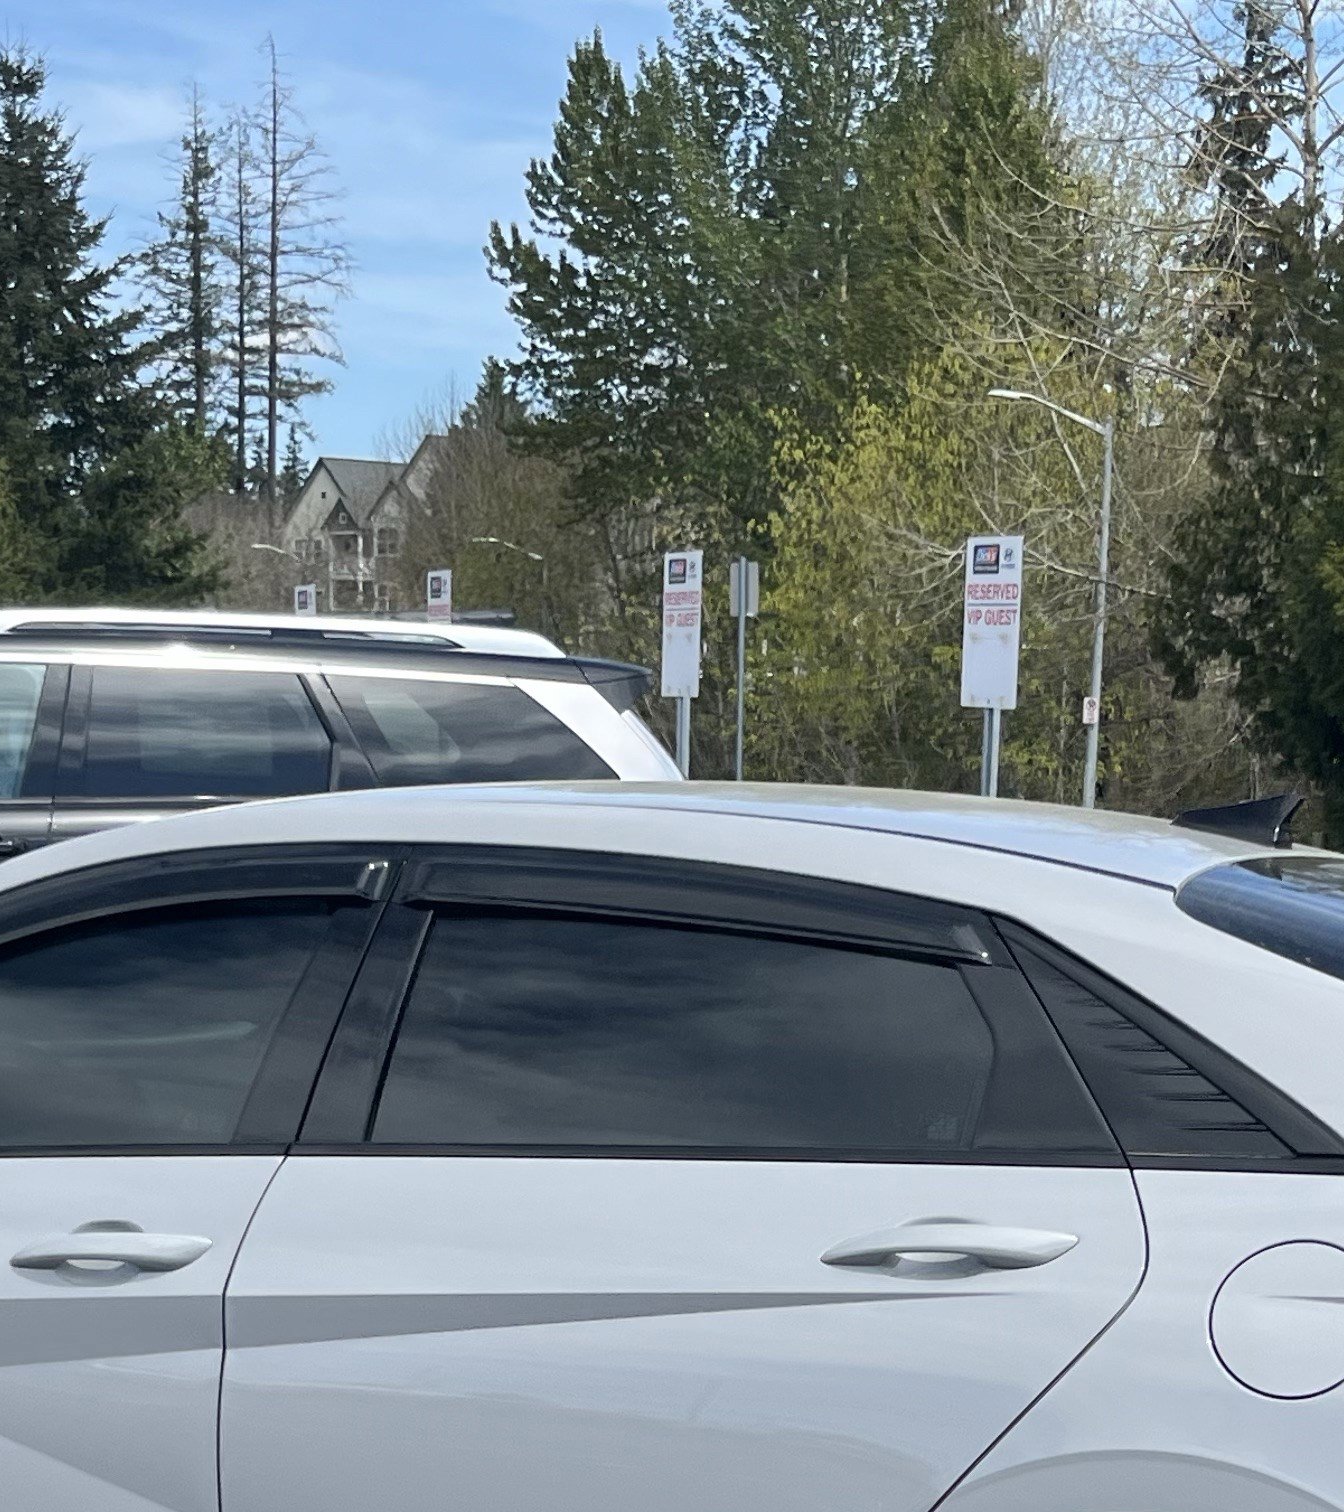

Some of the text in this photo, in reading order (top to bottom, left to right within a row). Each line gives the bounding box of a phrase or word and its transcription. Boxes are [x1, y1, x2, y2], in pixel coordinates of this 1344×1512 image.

[967, 582, 1019, 600] RESERVED
[967, 608, 1018, 626] VIP GUEST
